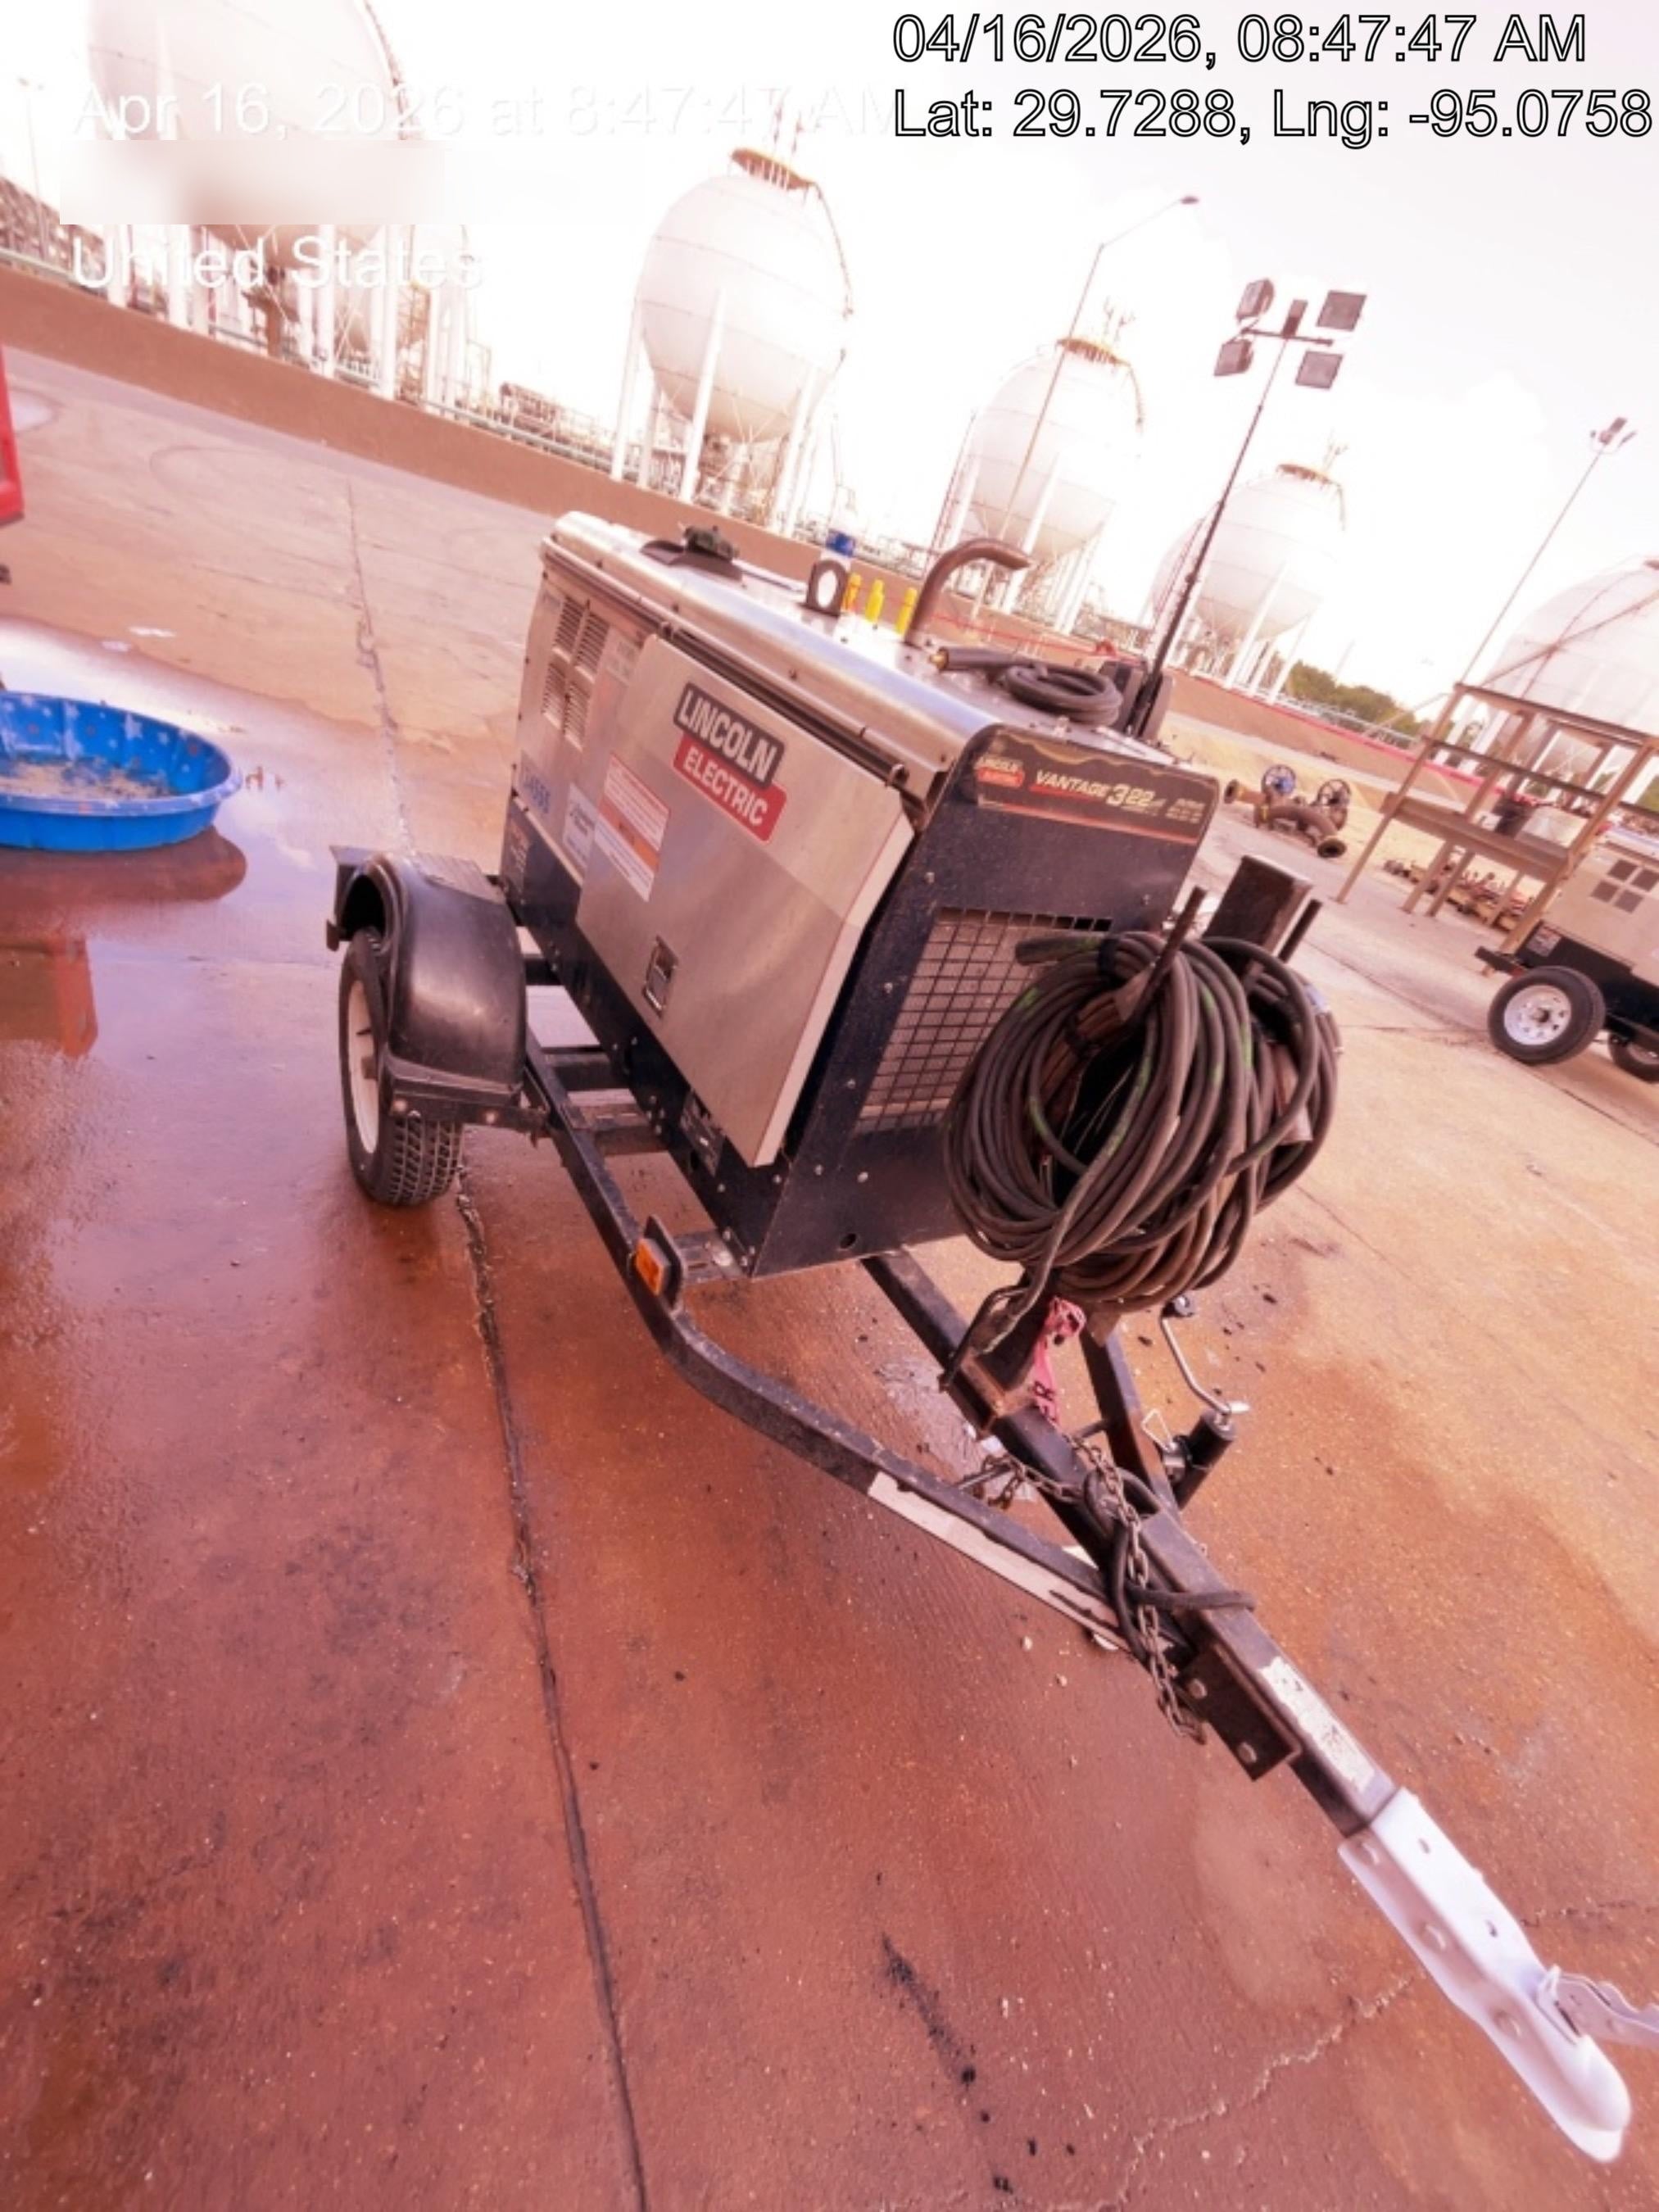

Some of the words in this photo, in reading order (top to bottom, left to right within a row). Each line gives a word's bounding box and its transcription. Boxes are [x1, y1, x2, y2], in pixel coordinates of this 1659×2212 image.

[678, 689, 777, 782] LINCOLN
[682, 746, 768, 827] ELECTRIC
[1036, 769, 1108, 798] VANTAGE
